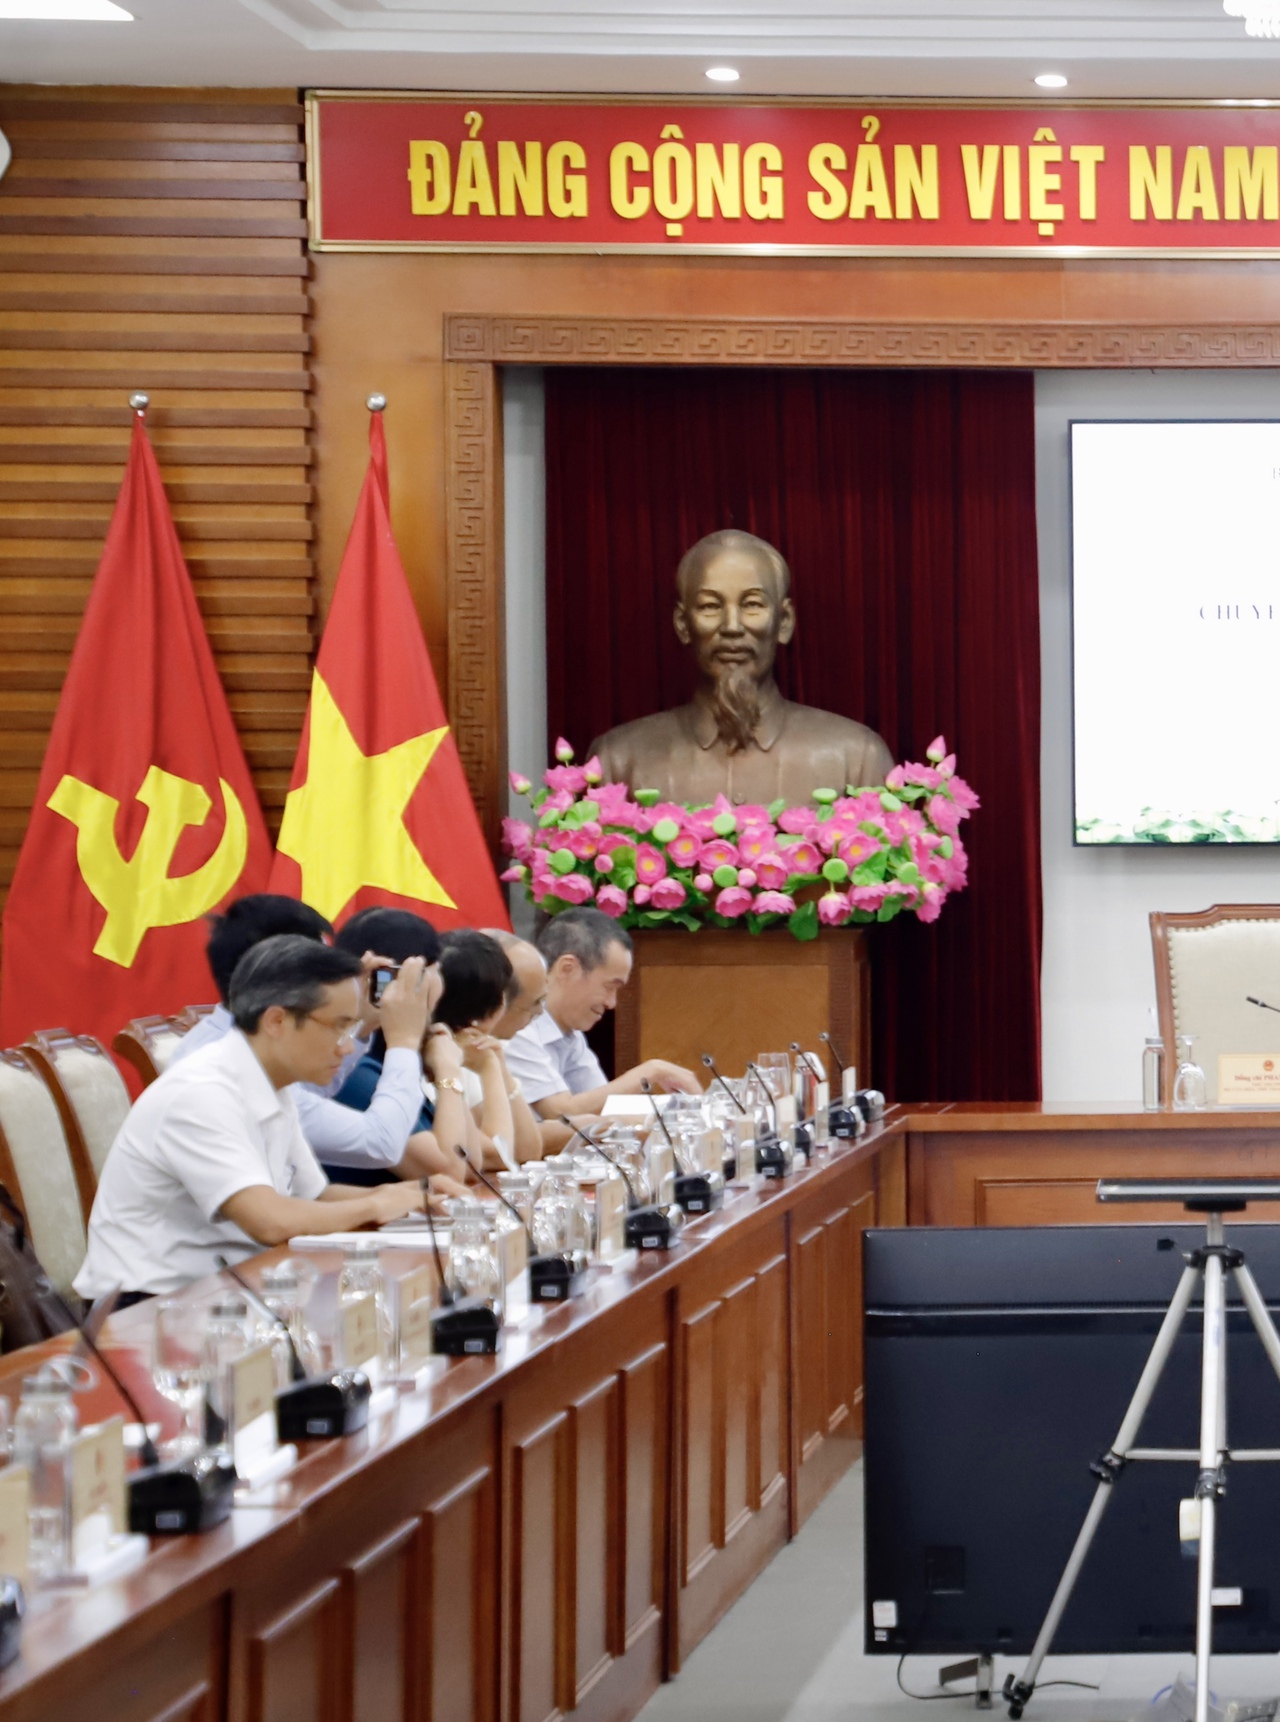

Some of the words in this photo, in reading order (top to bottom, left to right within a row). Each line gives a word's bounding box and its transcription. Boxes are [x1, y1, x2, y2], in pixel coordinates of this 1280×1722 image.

[408, 112, 589, 216] ĐẢNG
[609, 124, 784, 237] CỘNG
[807, 115, 939, 220] SẢN
[961, 127, 1105, 237] VIỆT
[1129, 146, 1280, 221] NAM
